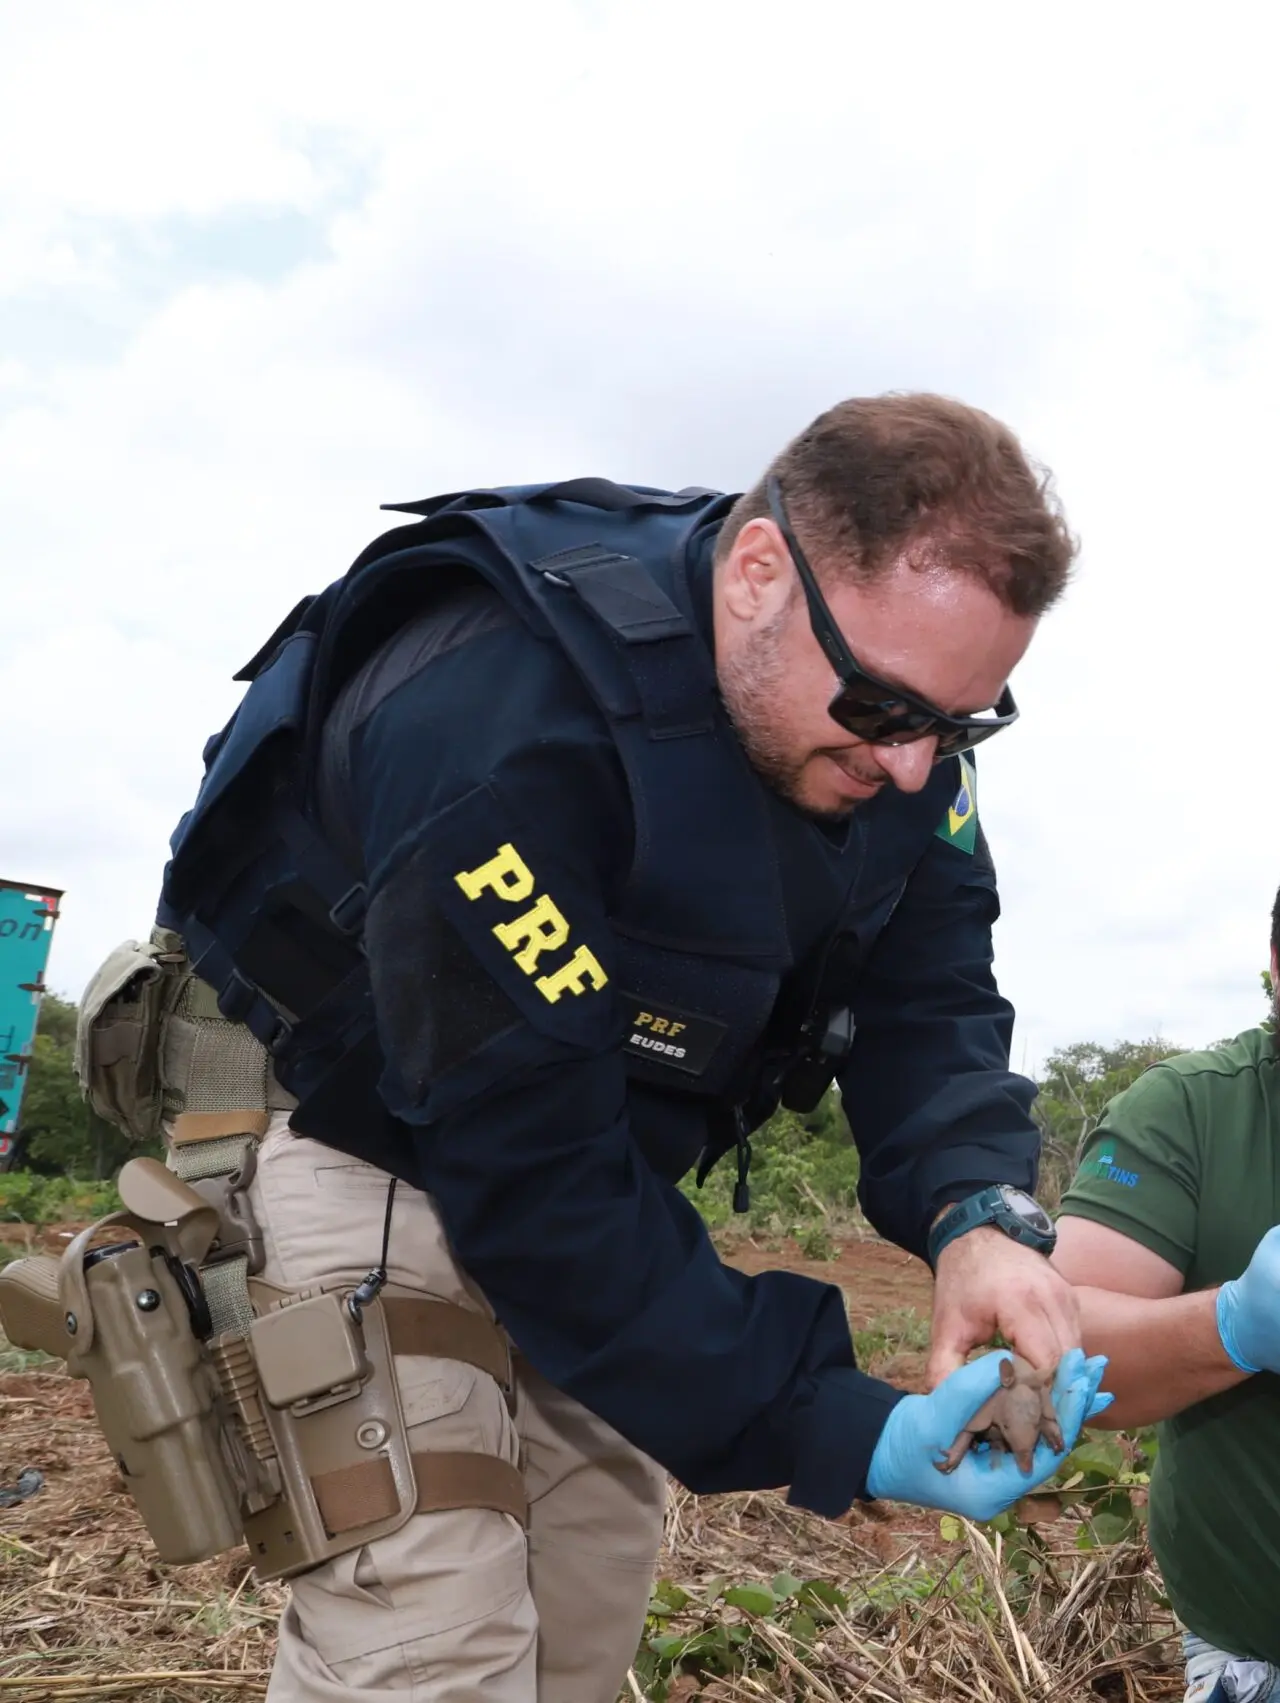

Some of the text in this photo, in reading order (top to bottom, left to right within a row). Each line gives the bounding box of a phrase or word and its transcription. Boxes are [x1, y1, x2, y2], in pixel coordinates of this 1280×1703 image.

[453, 842, 609, 1004] PRF
[633, 1011, 687, 1037] PRF
[629, 1033, 687, 1059] EUDES
